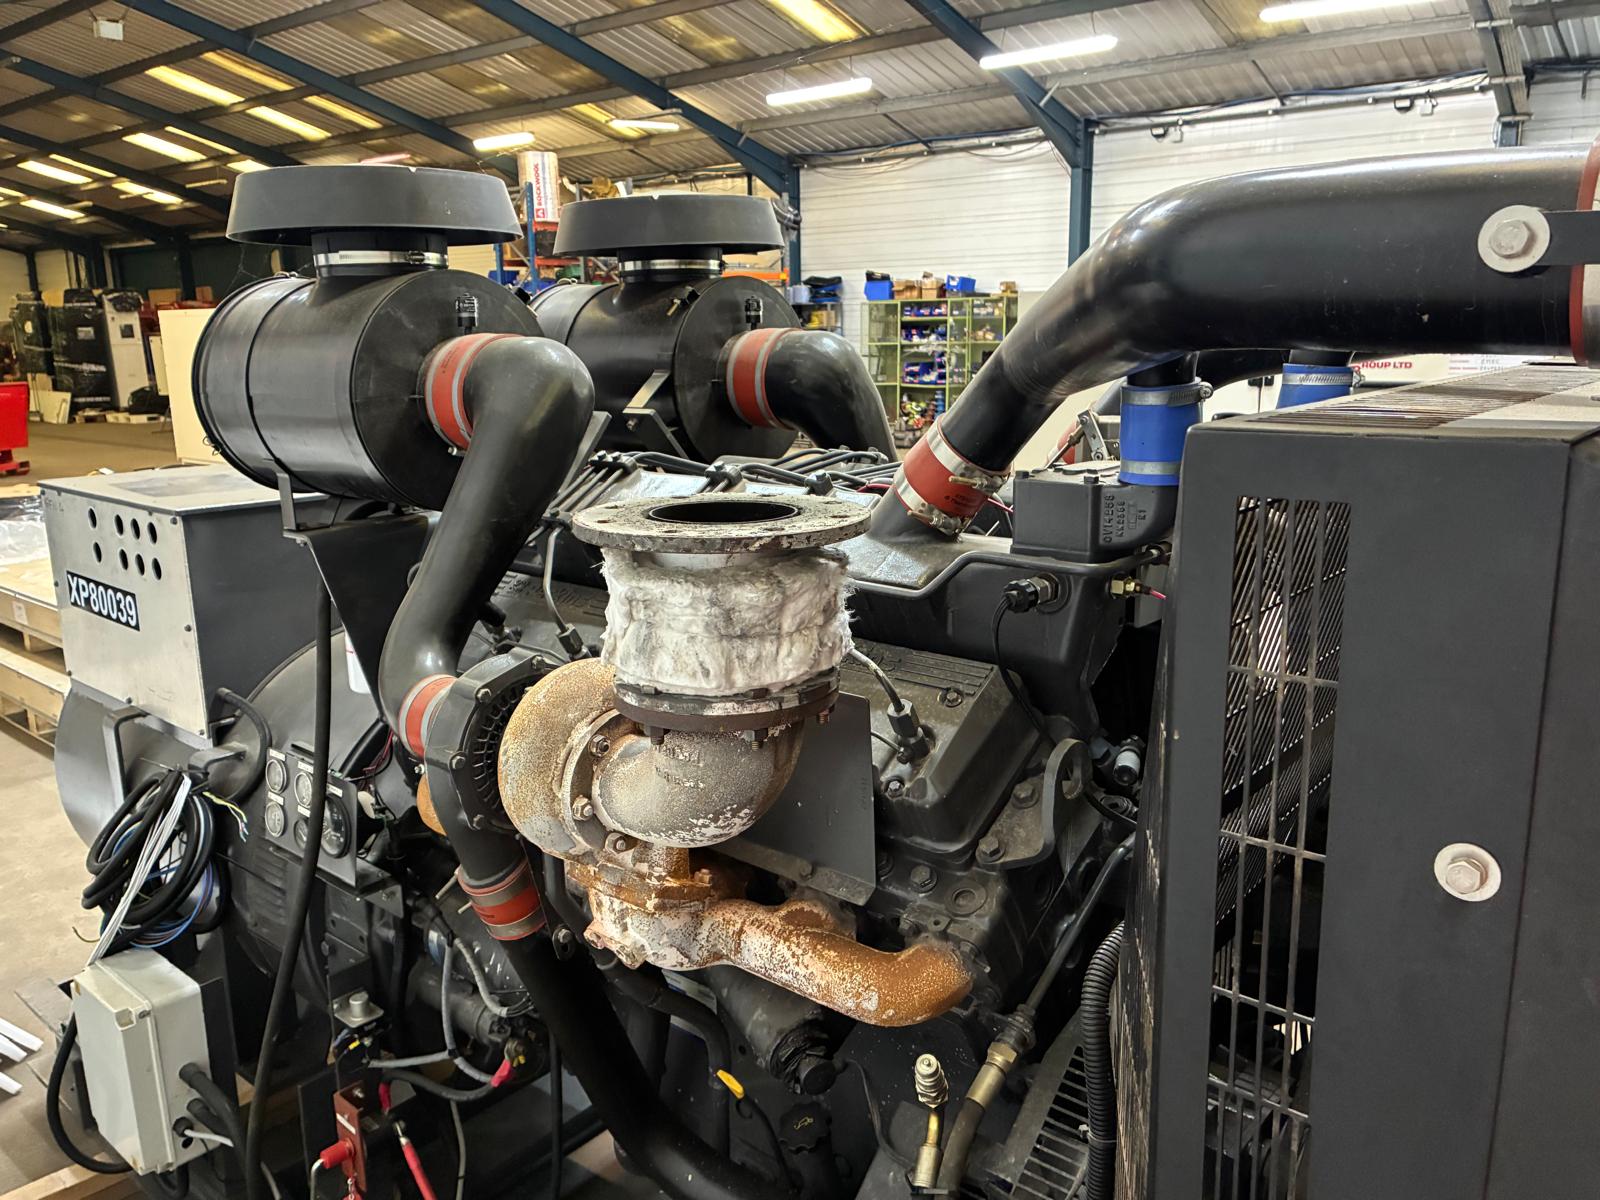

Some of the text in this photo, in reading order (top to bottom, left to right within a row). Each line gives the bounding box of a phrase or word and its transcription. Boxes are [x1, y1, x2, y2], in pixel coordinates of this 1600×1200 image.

[533, 163, 543, 206] ROCKWOOL
[1393, 361, 1412, 369] LTD
[67, 574, 137, 627] XP80039
